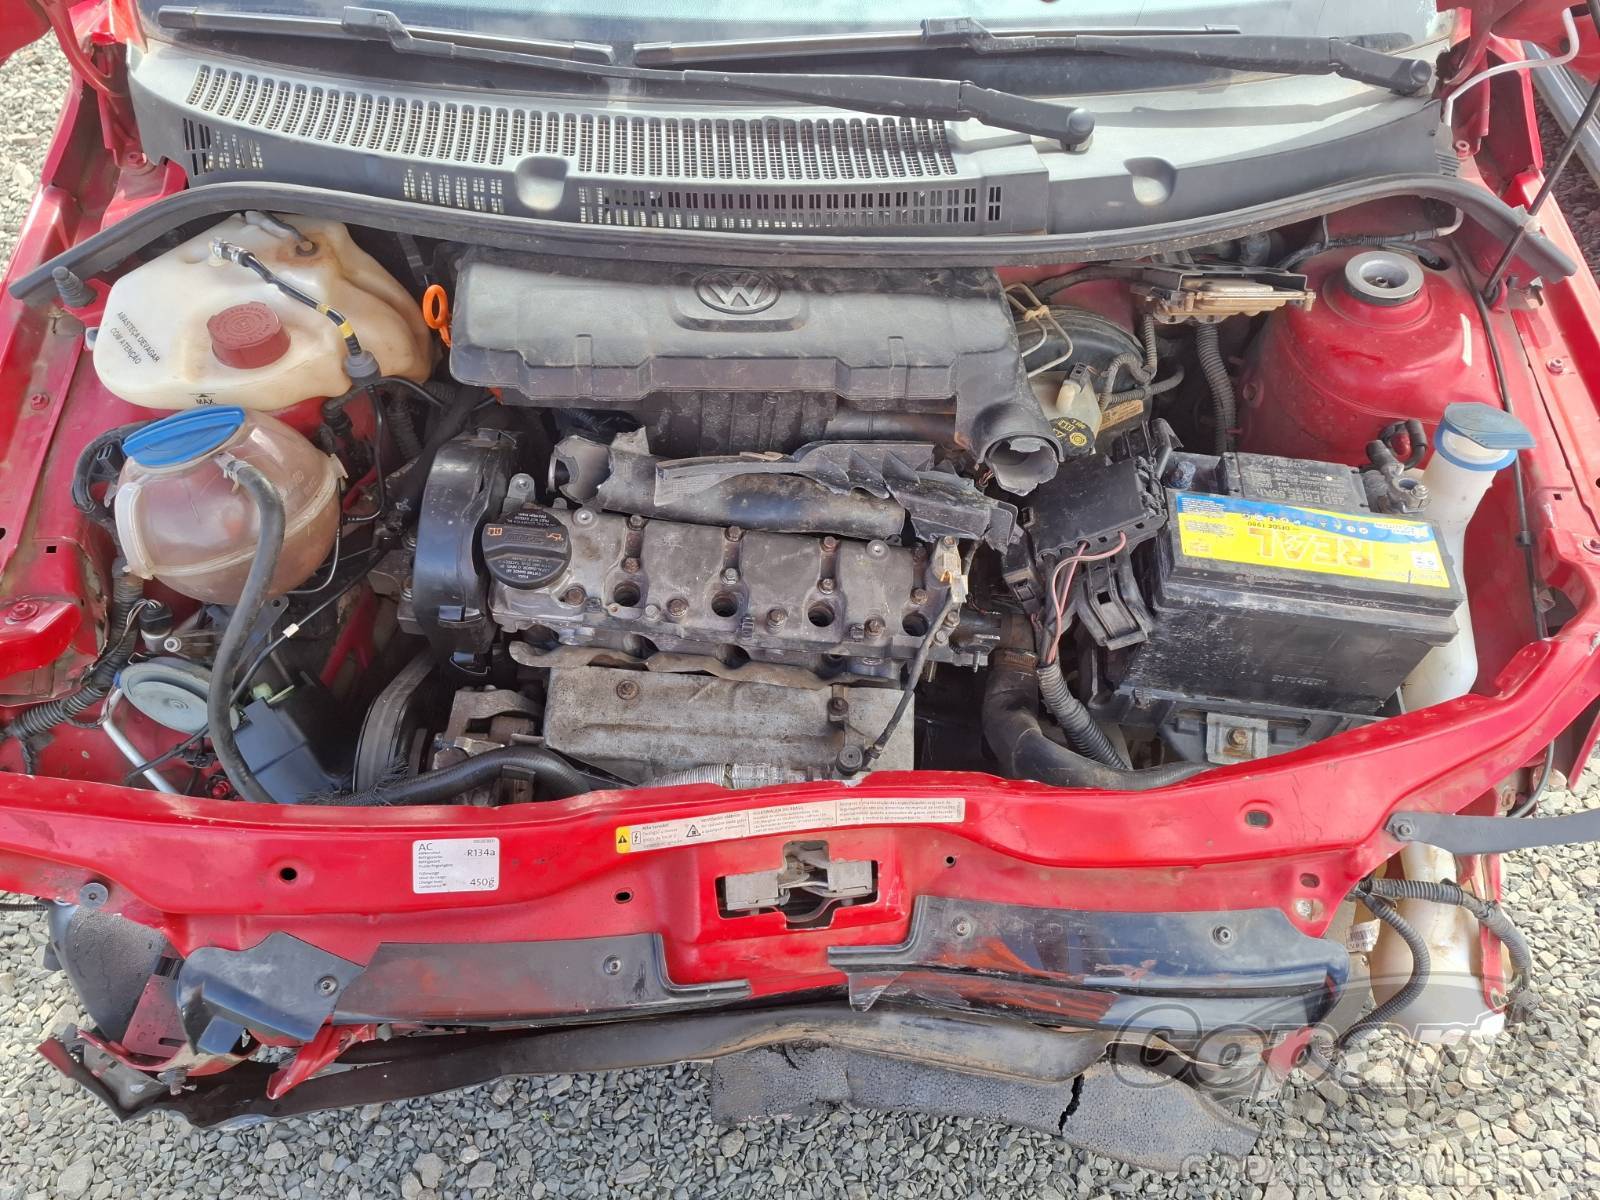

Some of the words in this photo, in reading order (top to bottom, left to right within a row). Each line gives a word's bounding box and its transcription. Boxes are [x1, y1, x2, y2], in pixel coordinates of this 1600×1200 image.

[137, 336, 161, 362] DEVAGAR
[1247, 527, 1373, 570] REAL
[418, 842, 433, 851] AC
[467, 848, 496, 857] R134a
[469, 878, 495, 888] 450g
